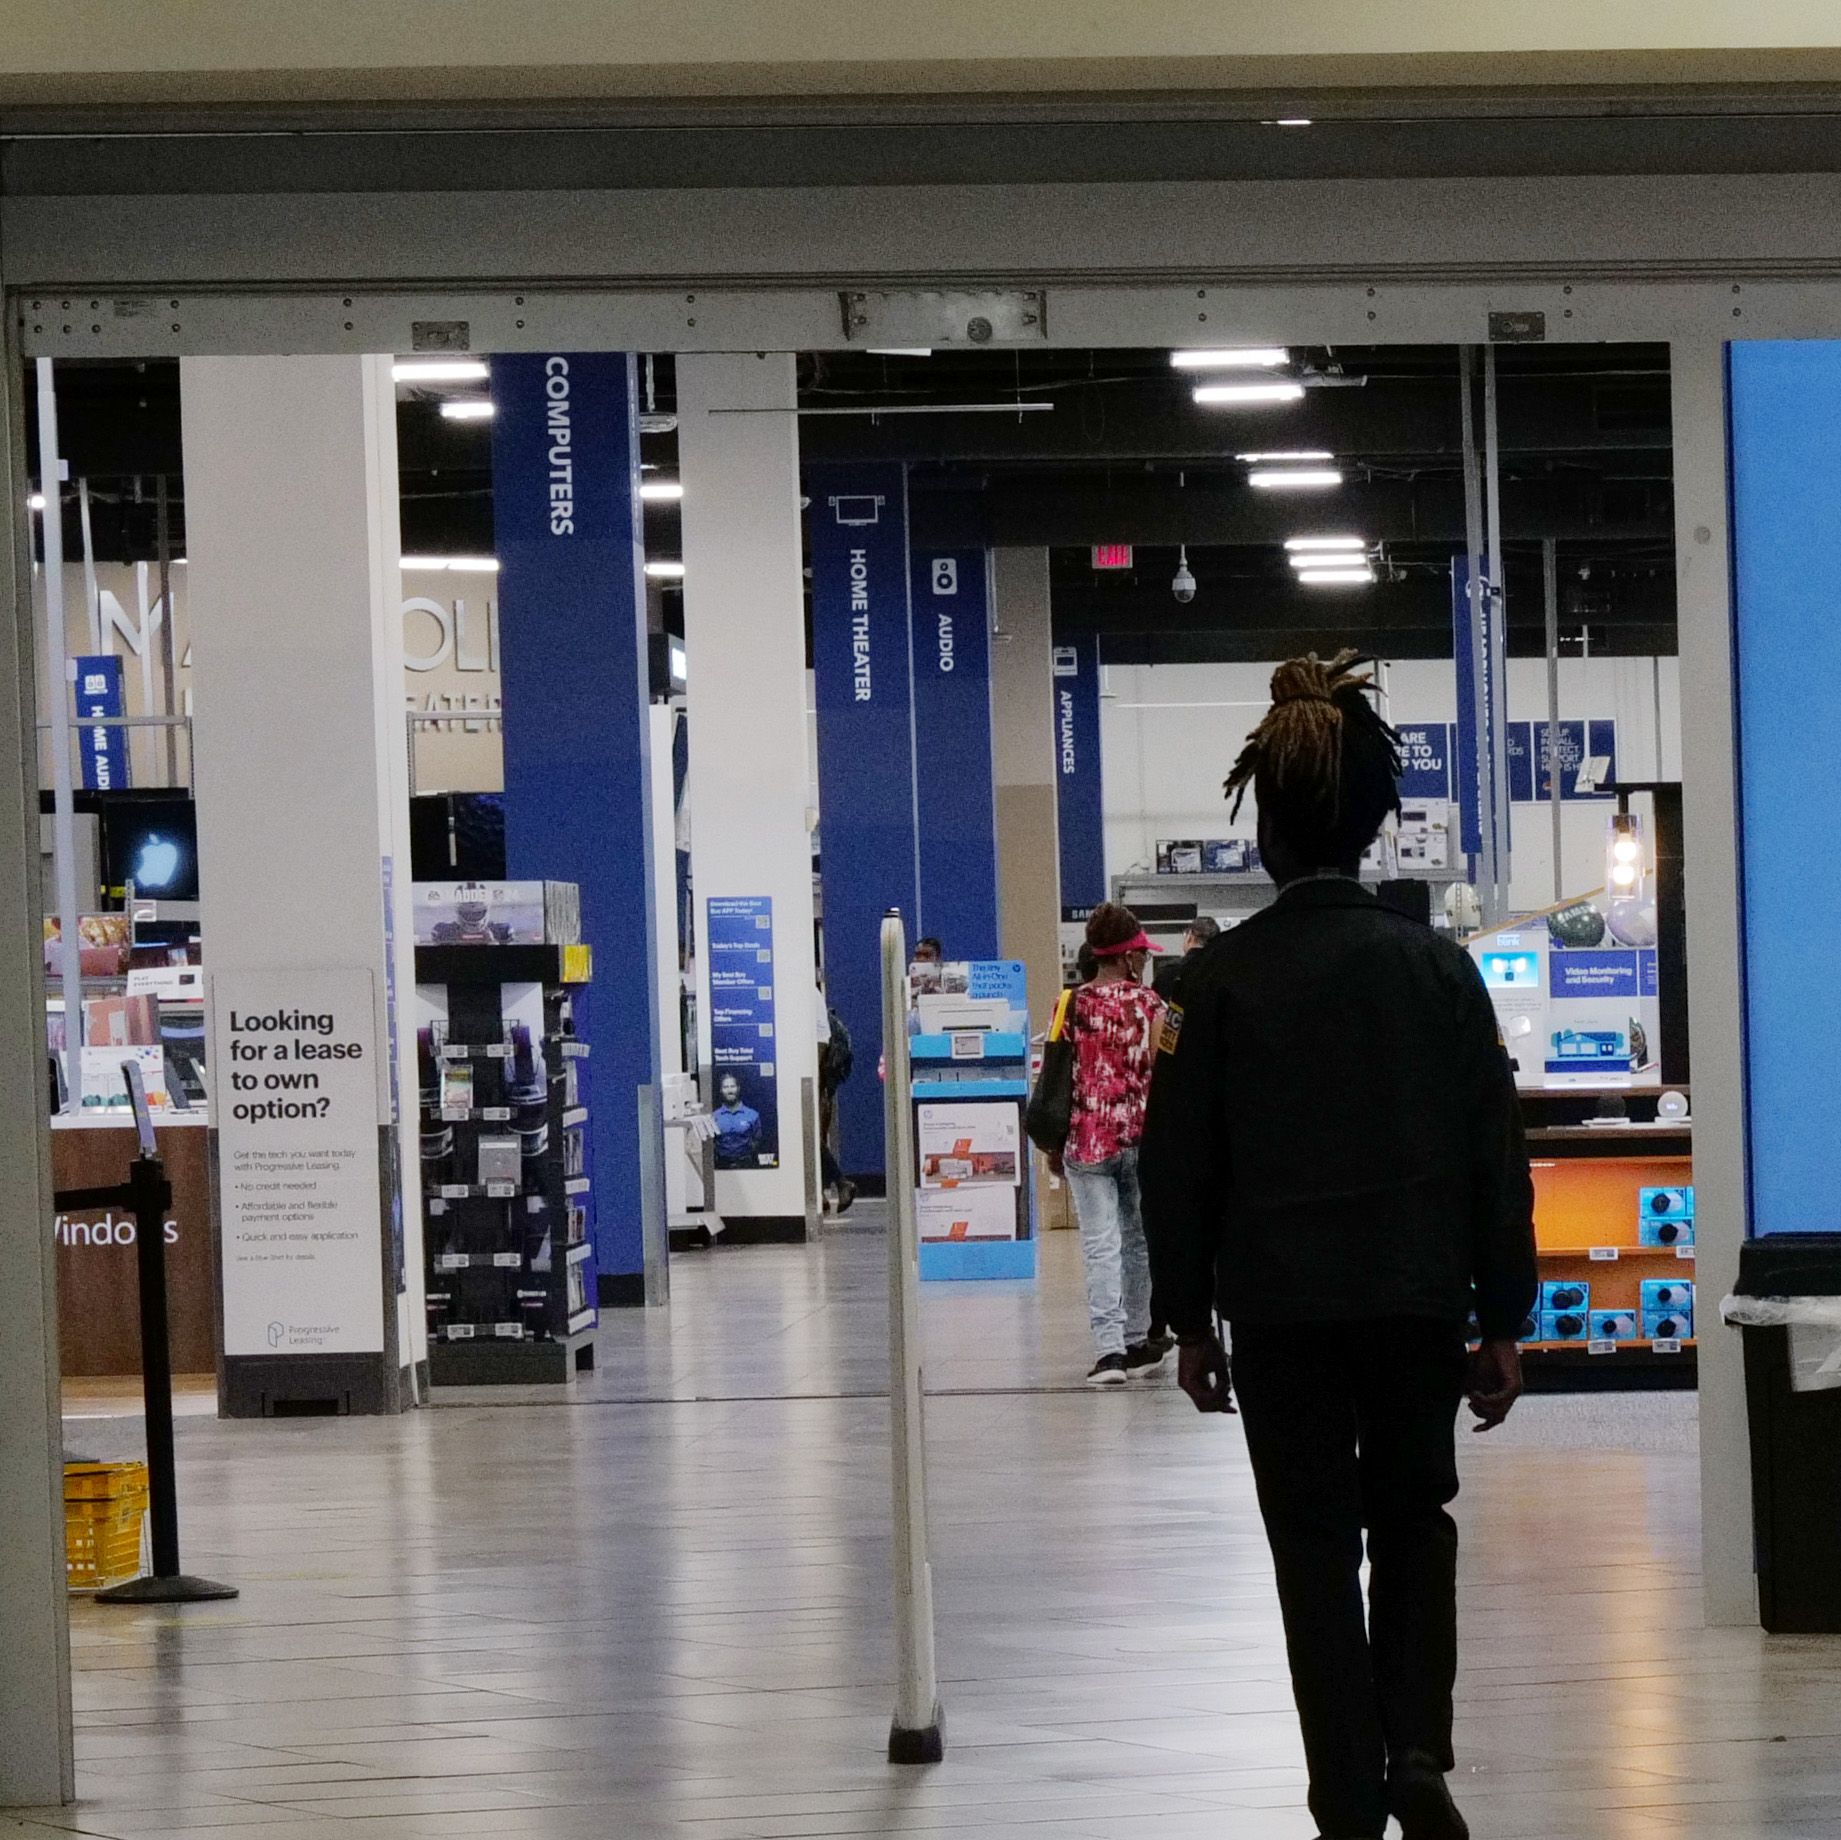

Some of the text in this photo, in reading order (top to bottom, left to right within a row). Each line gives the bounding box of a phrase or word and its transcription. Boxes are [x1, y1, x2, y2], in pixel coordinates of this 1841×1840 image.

[545, 356, 574, 536] COMPUTERS
[850, 549, 872, 702] HOME THEATER
[938, 613, 955, 672] AUDIO
[1060, 690, 1076, 775] APPLIANCES
[1414, 745, 1432, 757] TO
[1412, 758, 1442, 771] YOU
[1564, 966, 1633, 976] Video Monitoring
[1565, 975, 1615, 985] and Security
[230, 1009, 334, 1035] Looking
[230, 1038, 363, 1061] for a lease
[231, 1071, 319, 1091] to own
[232, 1096, 331, 1125] option?
[233, 1149, 356, 1160] Get the tech you want today
[234, 1162, 253, 1171] with
[255, 1162, 305, 1173] Progressive
[240, 1182, 317, 1191] No credit needed
[241, 1201, 338, 1211] Affordable and flexible
[241, 1212, 314, 1223] payment options
[55, 1213, 179, 1246] indos
[242, 1232, 359, 1242] Quick and easy application
[289, 1325, 340, 1335] Progressive
[289, 1337, 323, 1345] Leasing
